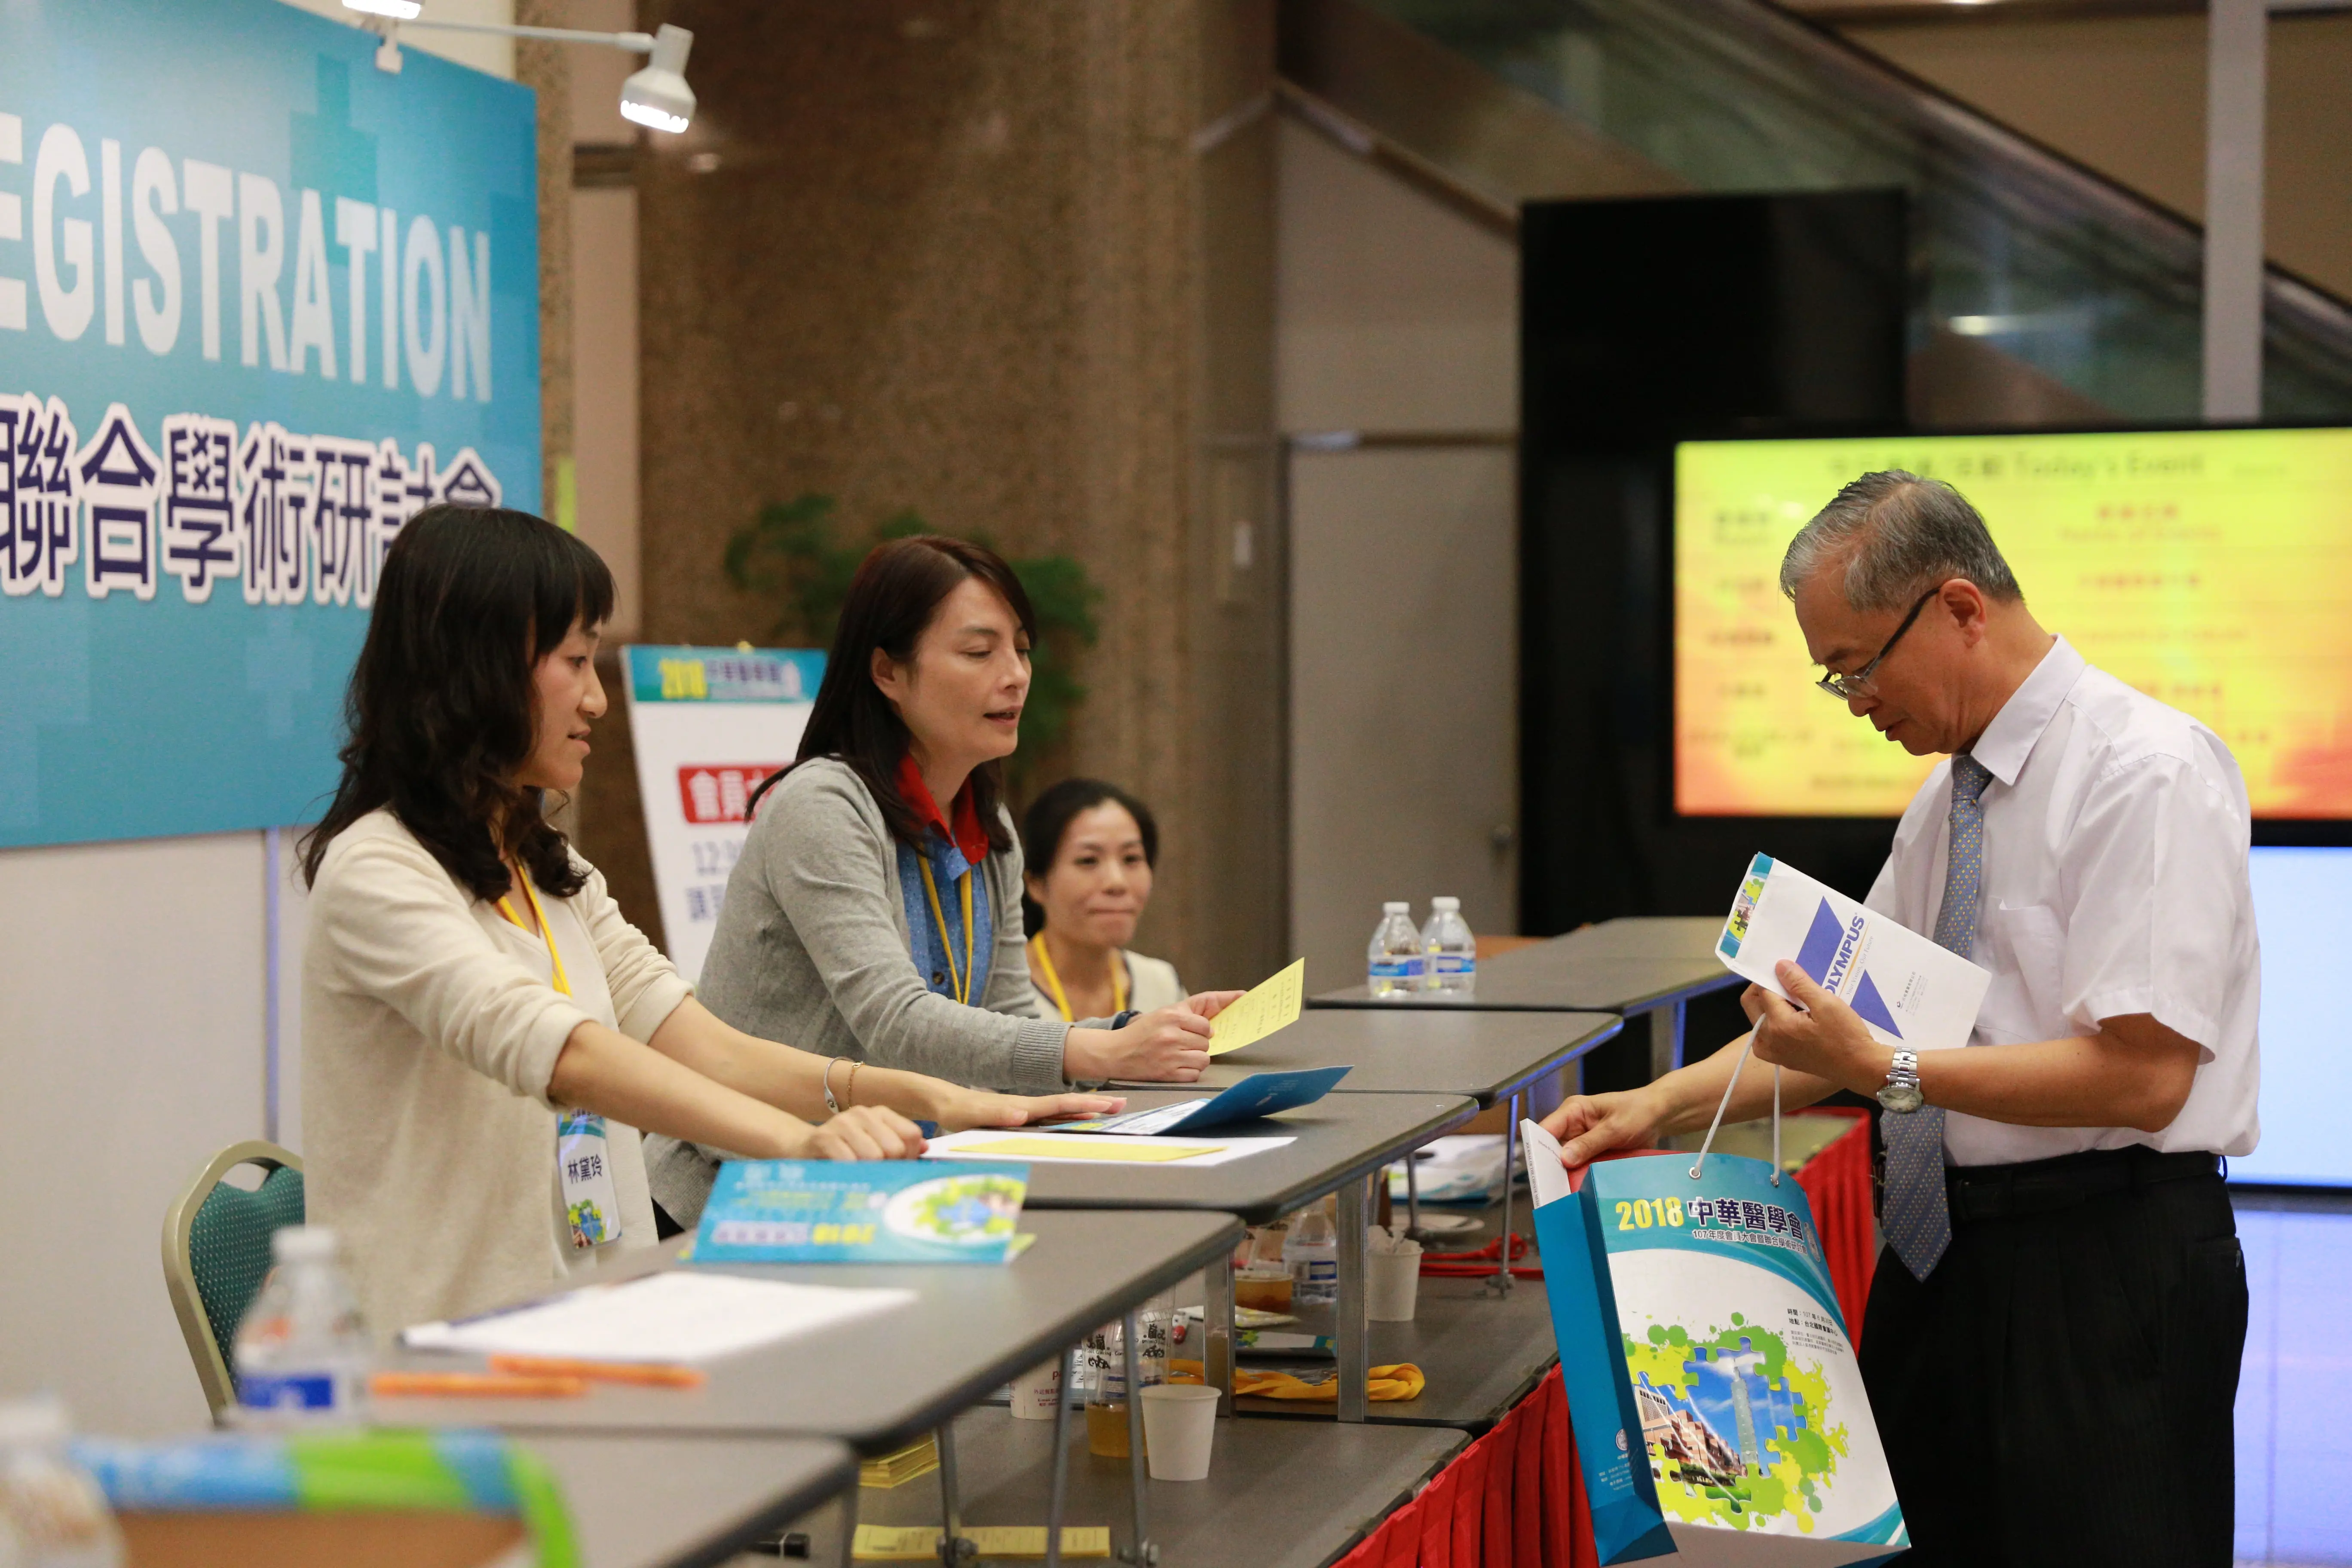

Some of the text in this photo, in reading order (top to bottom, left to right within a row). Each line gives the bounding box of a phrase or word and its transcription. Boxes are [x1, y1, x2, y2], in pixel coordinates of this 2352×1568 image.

[1864, 936, 1874, 952] Future
[568, 1154, 603, 1184] 林黛玲
[1616, 1197, 1684, 1231] 2018
[1687, 1196, 1805, 1241] 中華醫學會
